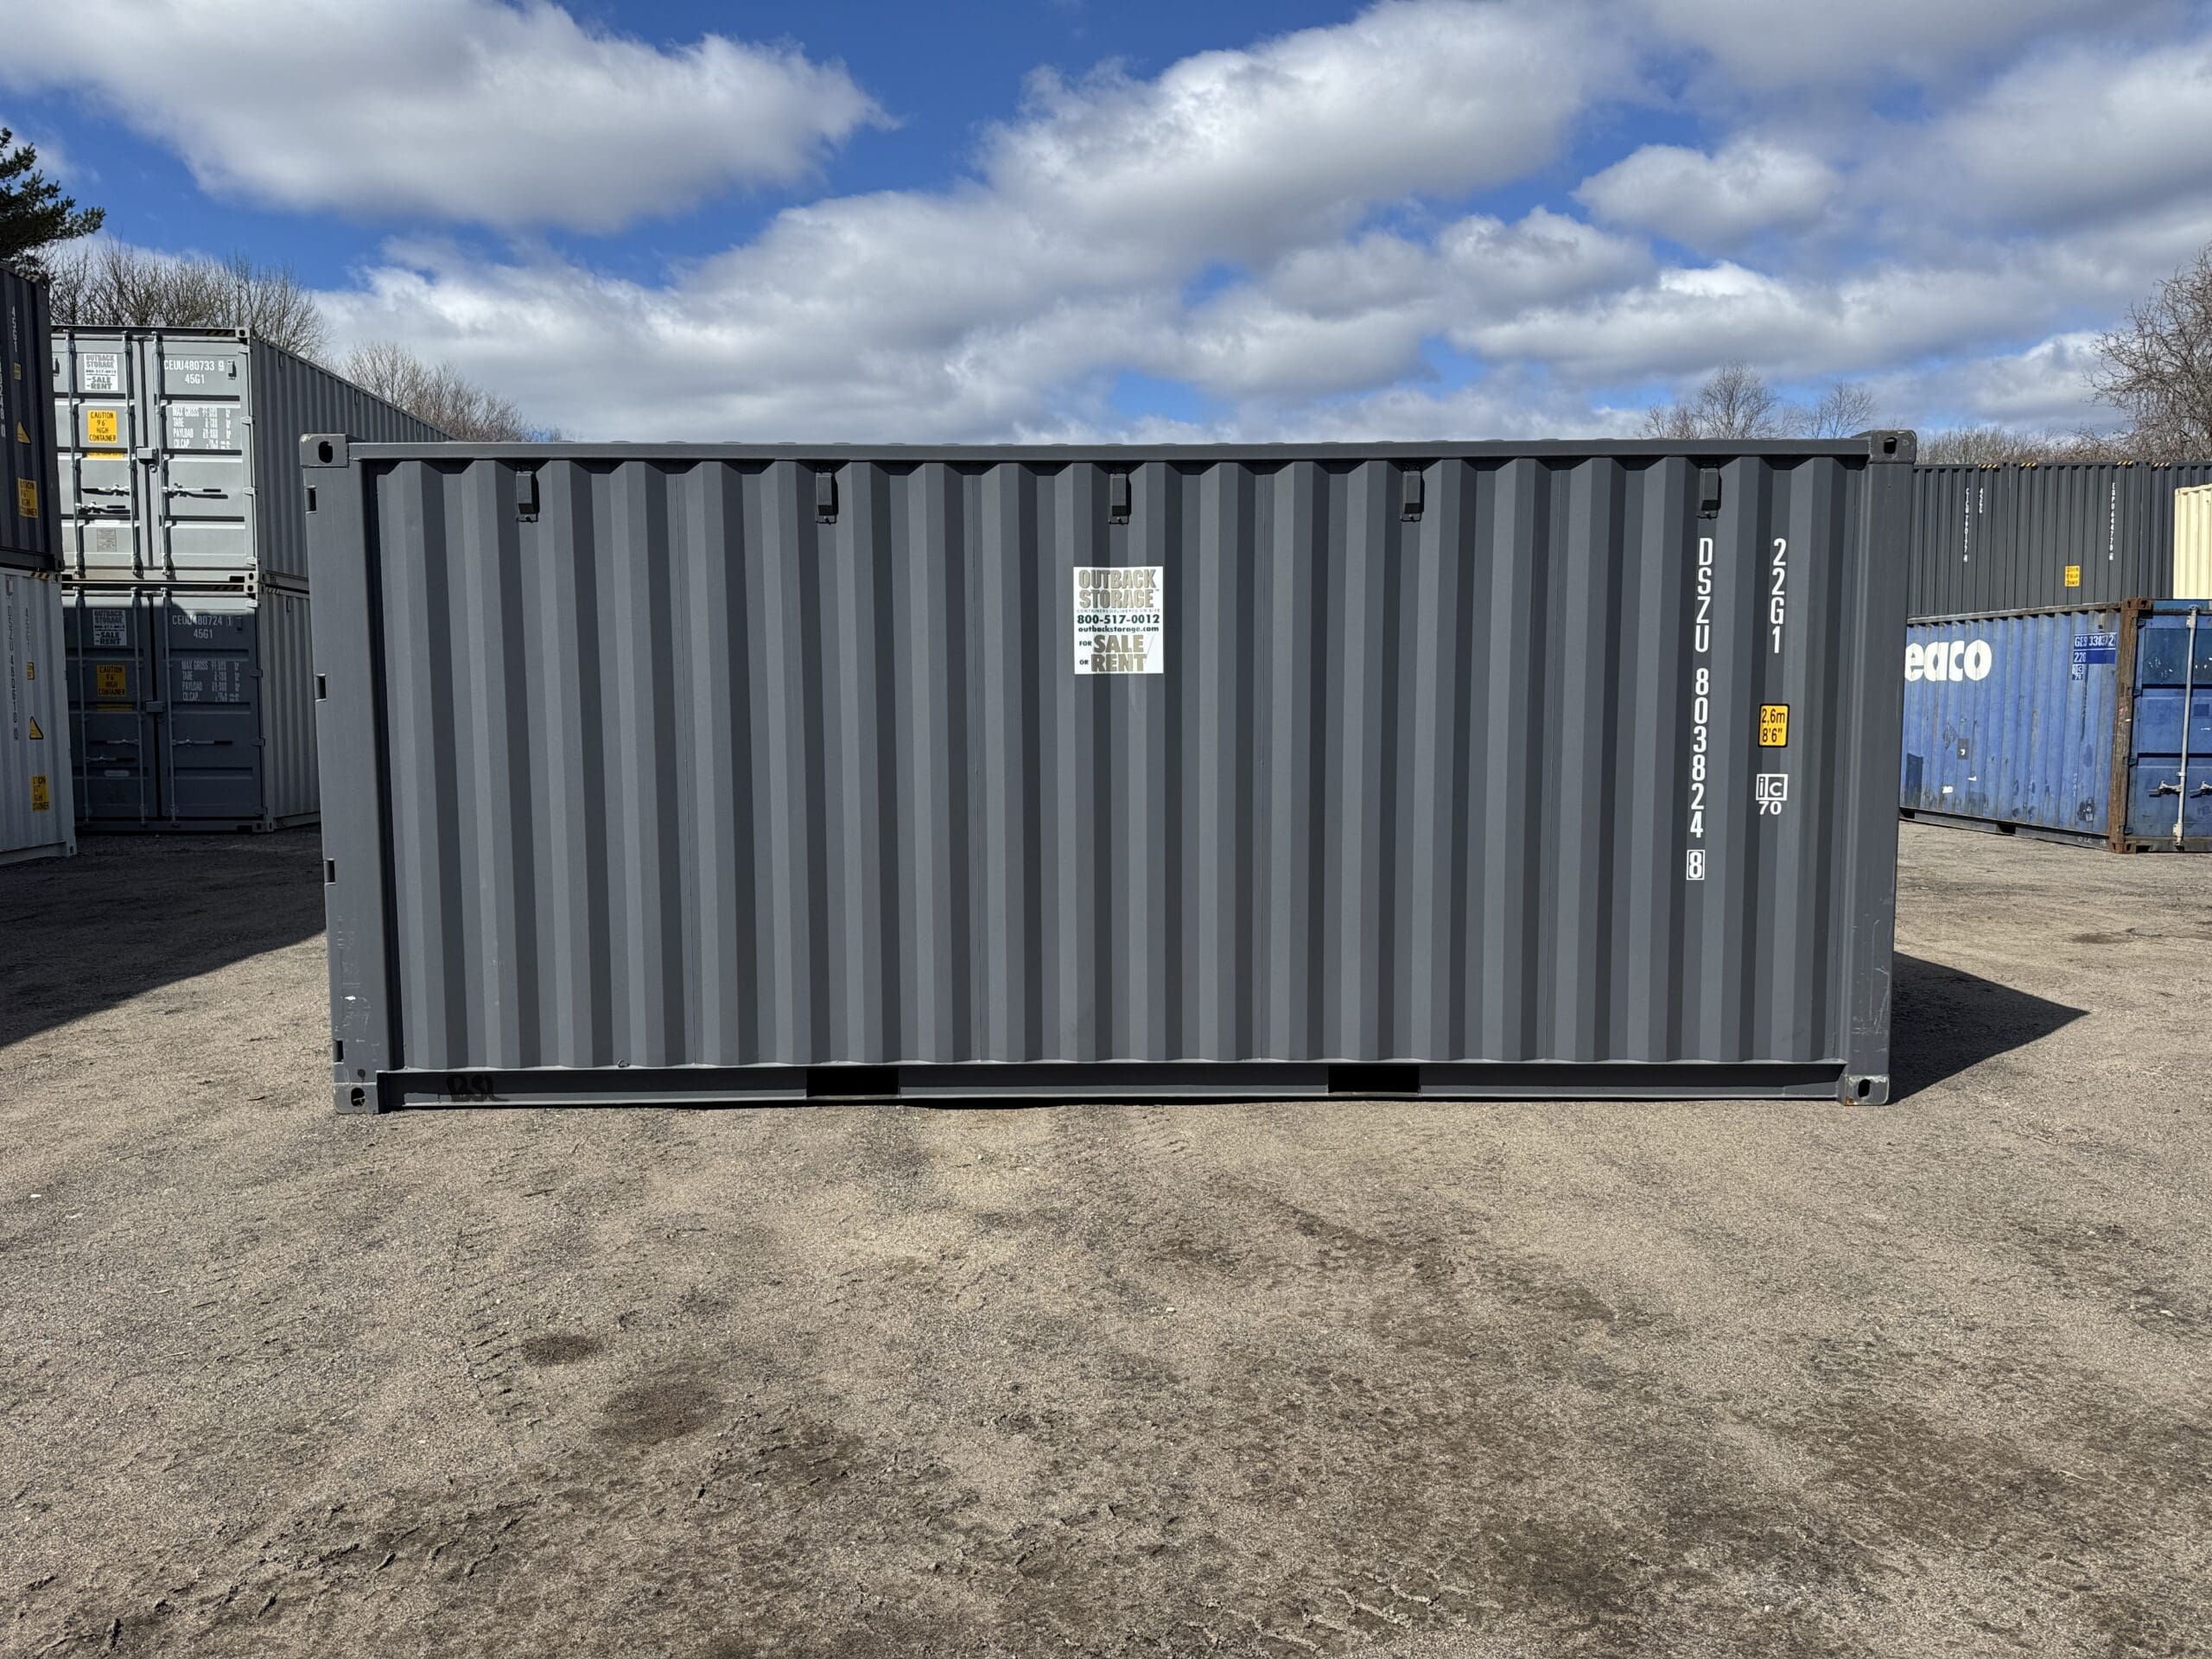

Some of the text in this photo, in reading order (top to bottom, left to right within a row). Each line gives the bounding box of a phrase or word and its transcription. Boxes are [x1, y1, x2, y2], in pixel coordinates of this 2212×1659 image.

[185, 374, 205, 385] 45G1
[173, 428, 194, 438] PAYLOAD
[1078, 569, 1157, 588] OUTBACK
[1079, 589, 1154, 608] STORAGE
[1770, 537, 1787, 654] 22G1
[1077, 614, 1160, 624] 800-517-0012
[194, 629, 213, 639] 45G1
[1078, 625, 1159, 633] outbackstorage.com
[1093, 634, 1144, 653] SALE
[1091, 654, 1147, 672] RENT
[181, 681, 203, 691] PAYLOAD
[1688, 537, 1713, 880] DSZU 803824 8
[1763, 728, 1783, 742] 8'6"
[1758, 801, 1782, 816] 70
